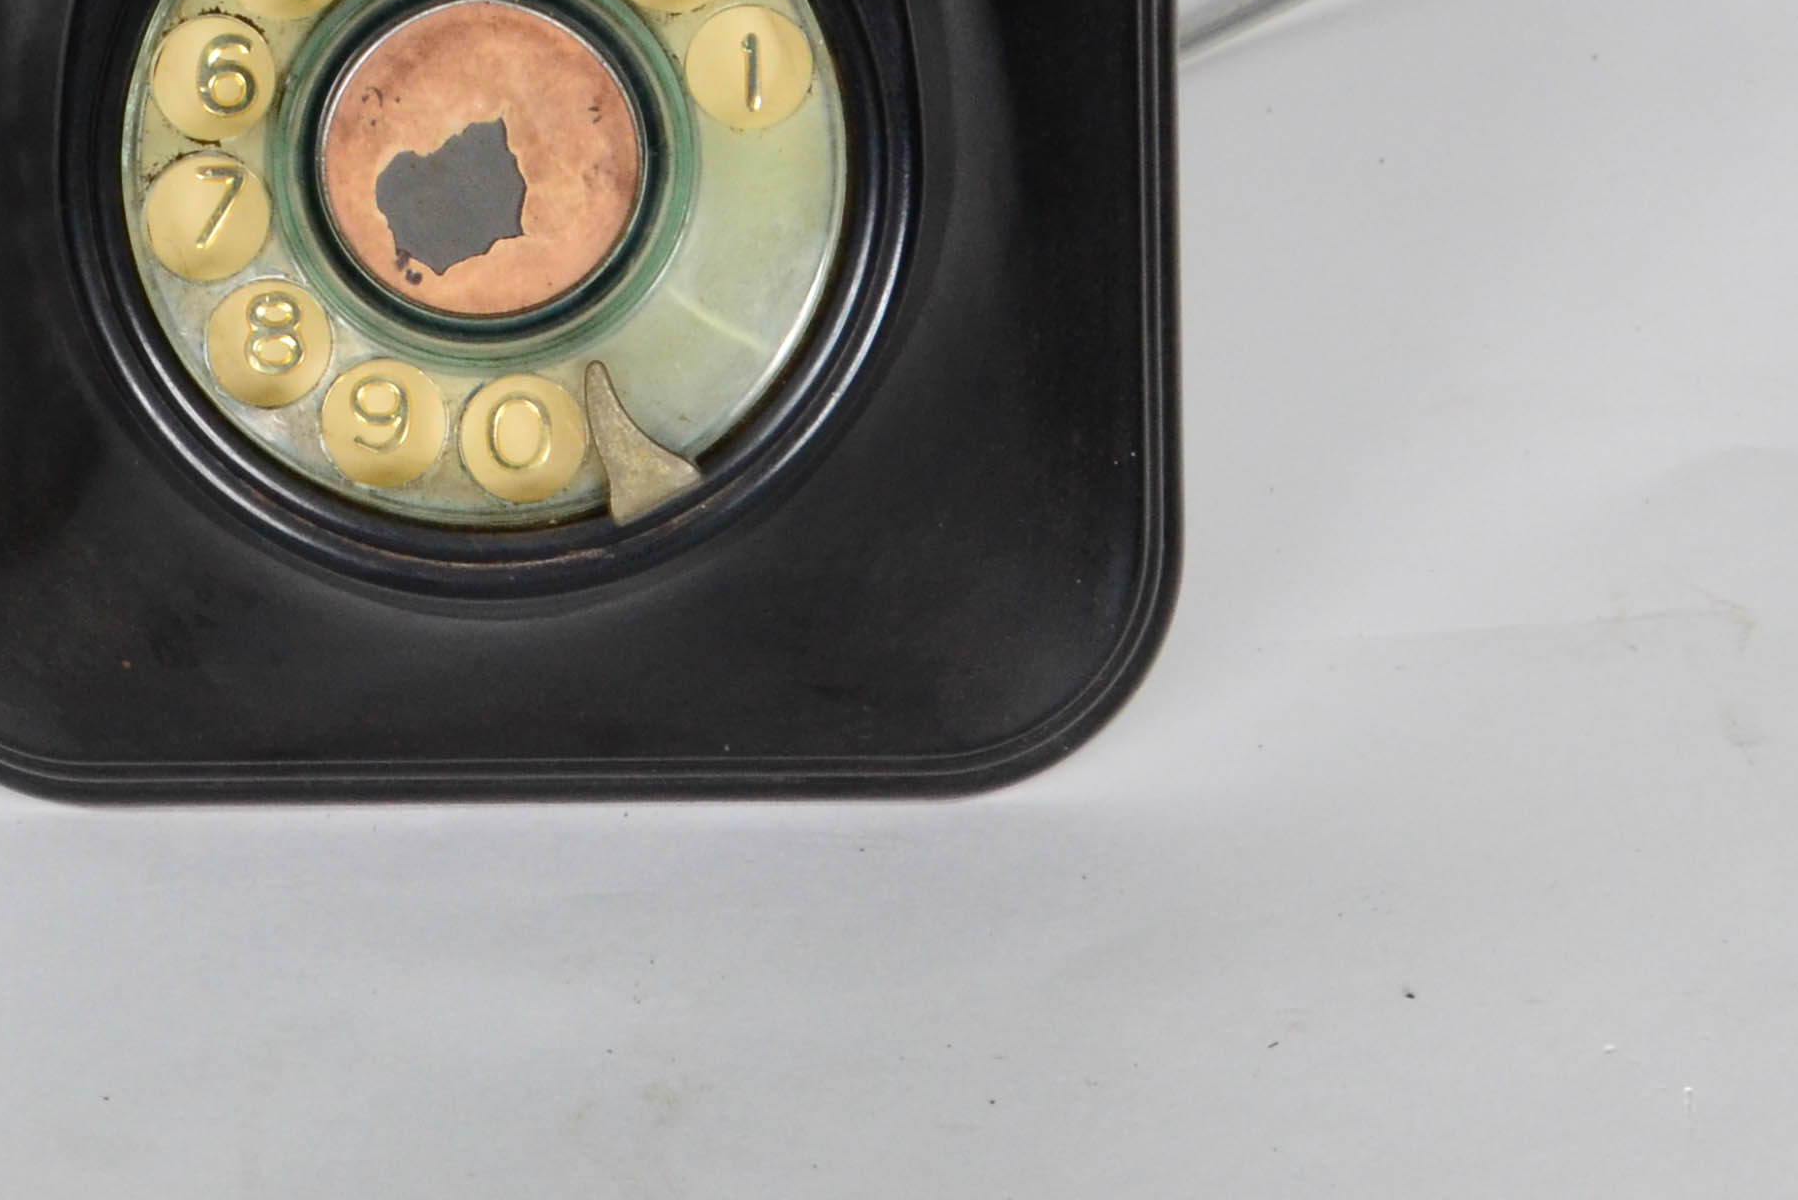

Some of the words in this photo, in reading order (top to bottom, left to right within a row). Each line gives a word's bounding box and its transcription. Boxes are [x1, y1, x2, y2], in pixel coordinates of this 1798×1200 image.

[196, 33, 257, 117] 6
[741, 32, 762, 112] 1
[196, 166, 244, 249] 7
[246, 292, 304, 374] 8
[351, 377, 410, 451] 9
